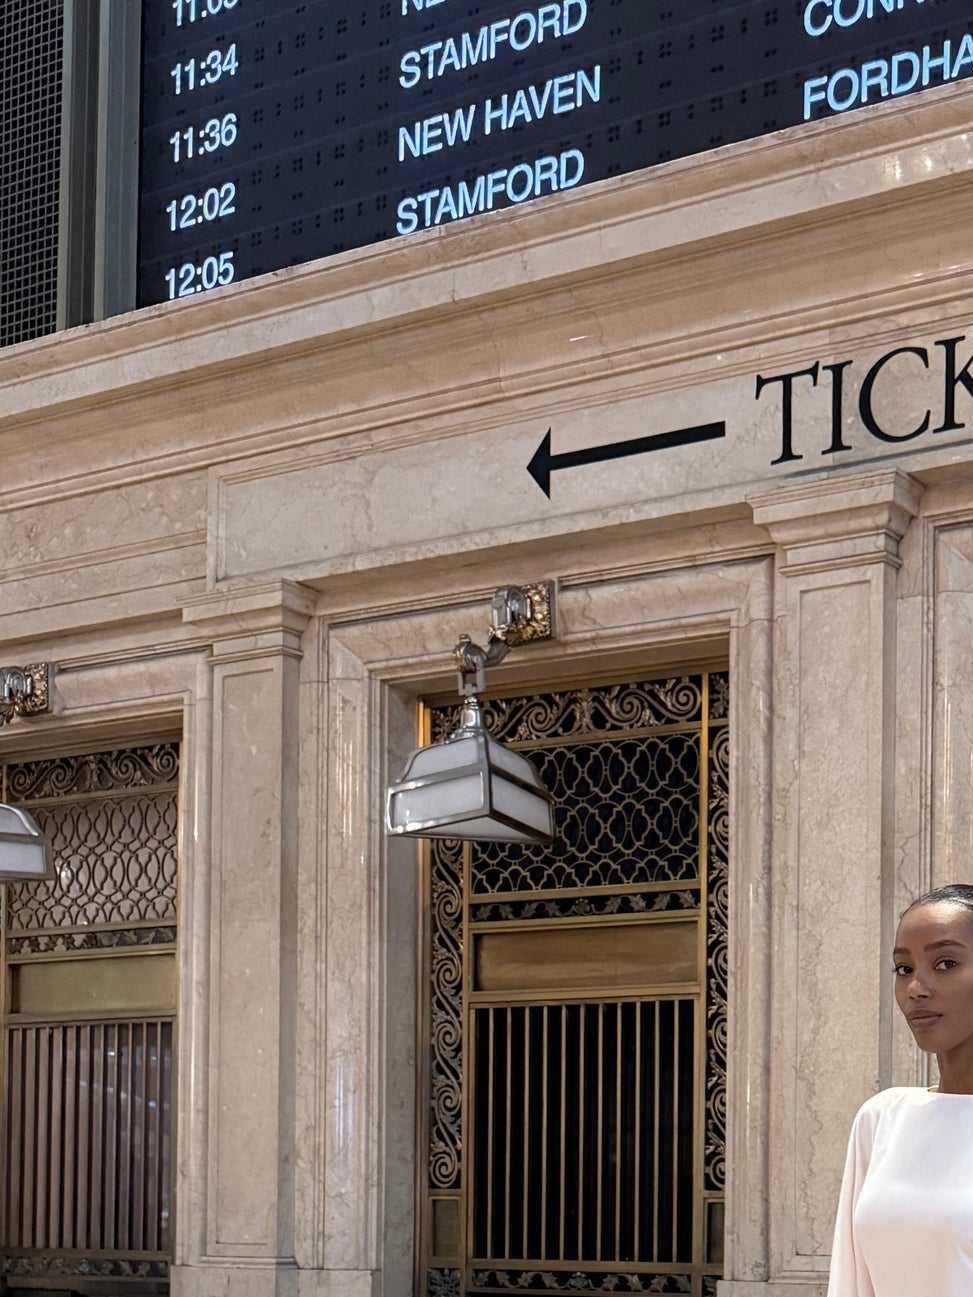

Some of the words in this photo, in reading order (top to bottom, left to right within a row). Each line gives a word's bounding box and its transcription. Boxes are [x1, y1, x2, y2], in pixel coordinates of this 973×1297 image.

[170, 43, 239, 95] 11:34
[398, 0, 588, 89] STAMFORD
[169, 112, 237, 163] 11:36
[398, 104, 476, 162] NEW
[484, 64, 601, 136] HAVEN
[166, 182, 236, 232] 12:02
[396, 148, 585, 236] STAMFORD
[164, 251, 235, 300] 12:05
